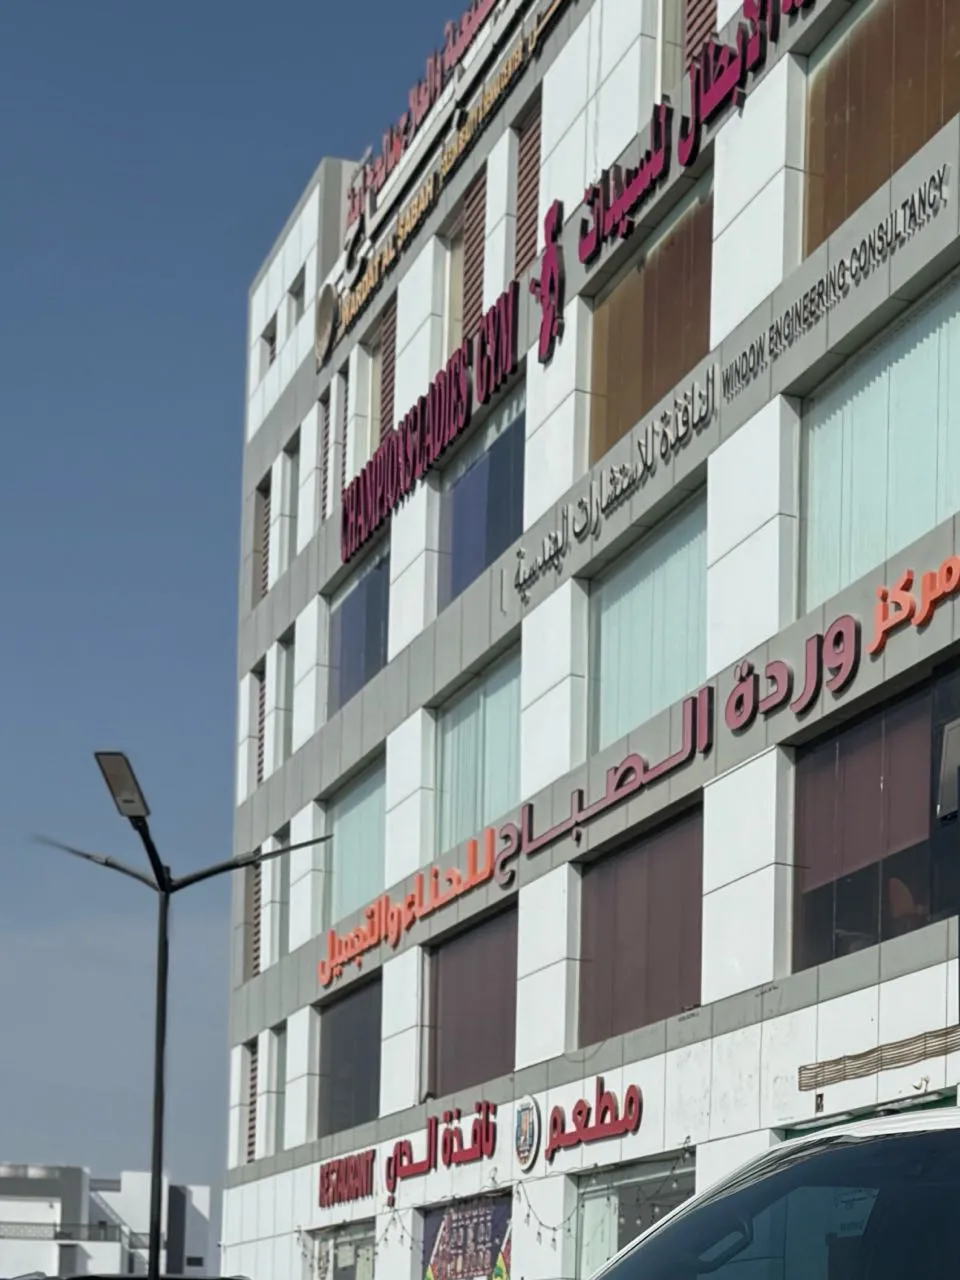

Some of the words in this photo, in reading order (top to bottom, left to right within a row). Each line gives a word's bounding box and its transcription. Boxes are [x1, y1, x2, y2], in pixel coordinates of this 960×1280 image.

[722, 333, 767, 398] WINDOW
[768, 258, 847, 356] ENGINEERING
[849, 163, 948, 281] CONSULTANCY
[725, 615, 861, 732] وردة
[494, 686, 714, 887] الصباح
[545, 1076, 644, 1161] مطعم
